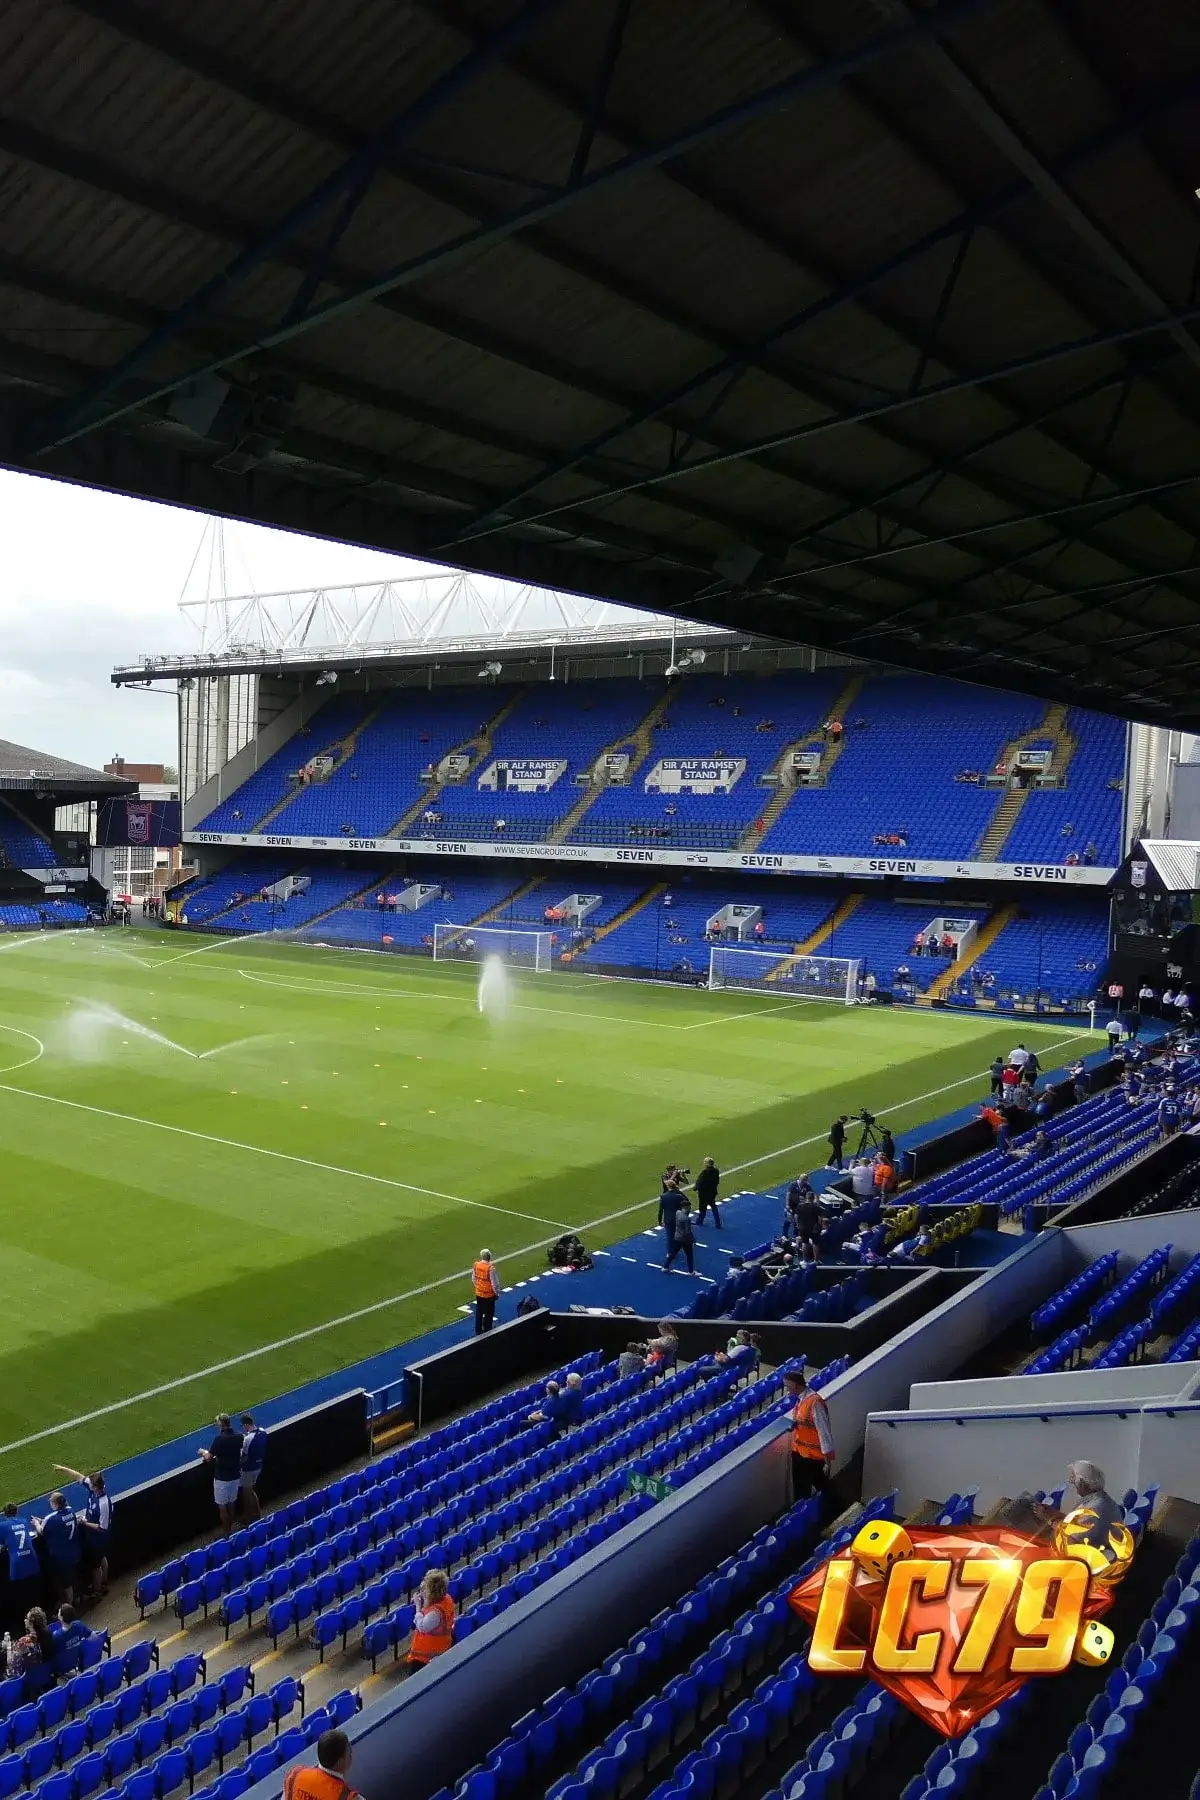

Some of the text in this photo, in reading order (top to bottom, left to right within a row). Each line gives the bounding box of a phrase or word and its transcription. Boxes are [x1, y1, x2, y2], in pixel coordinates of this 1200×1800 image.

[497, 762, 509, 770] SIR
[511, 761, 527, 770] ALF
[663, 761, 740, 769] SIR ALF RAMSEY
[515, 770, 542, 778] STAND
[684, 771, 717, 779] STAND
[199, 833, 223, 842] SEVEN
[266, 836, 292, 846] SEVEN
[348, 839, 376, 849] SEVEN
[435, 843, 467, 853] SEVEN
[494, 846, 588, 857] WWW.SEVENGROUP.CO.UK
[616, 850, 653, 861] SEVEN
[741, 855, 783, 867] SEVEN
[869, 860, 916, 873] SEVEN
[1013, 866, 1067, 879] SEVEN
[66, 1520, 75, 1540] 7
[14, 1530, 25, 1549] 7
